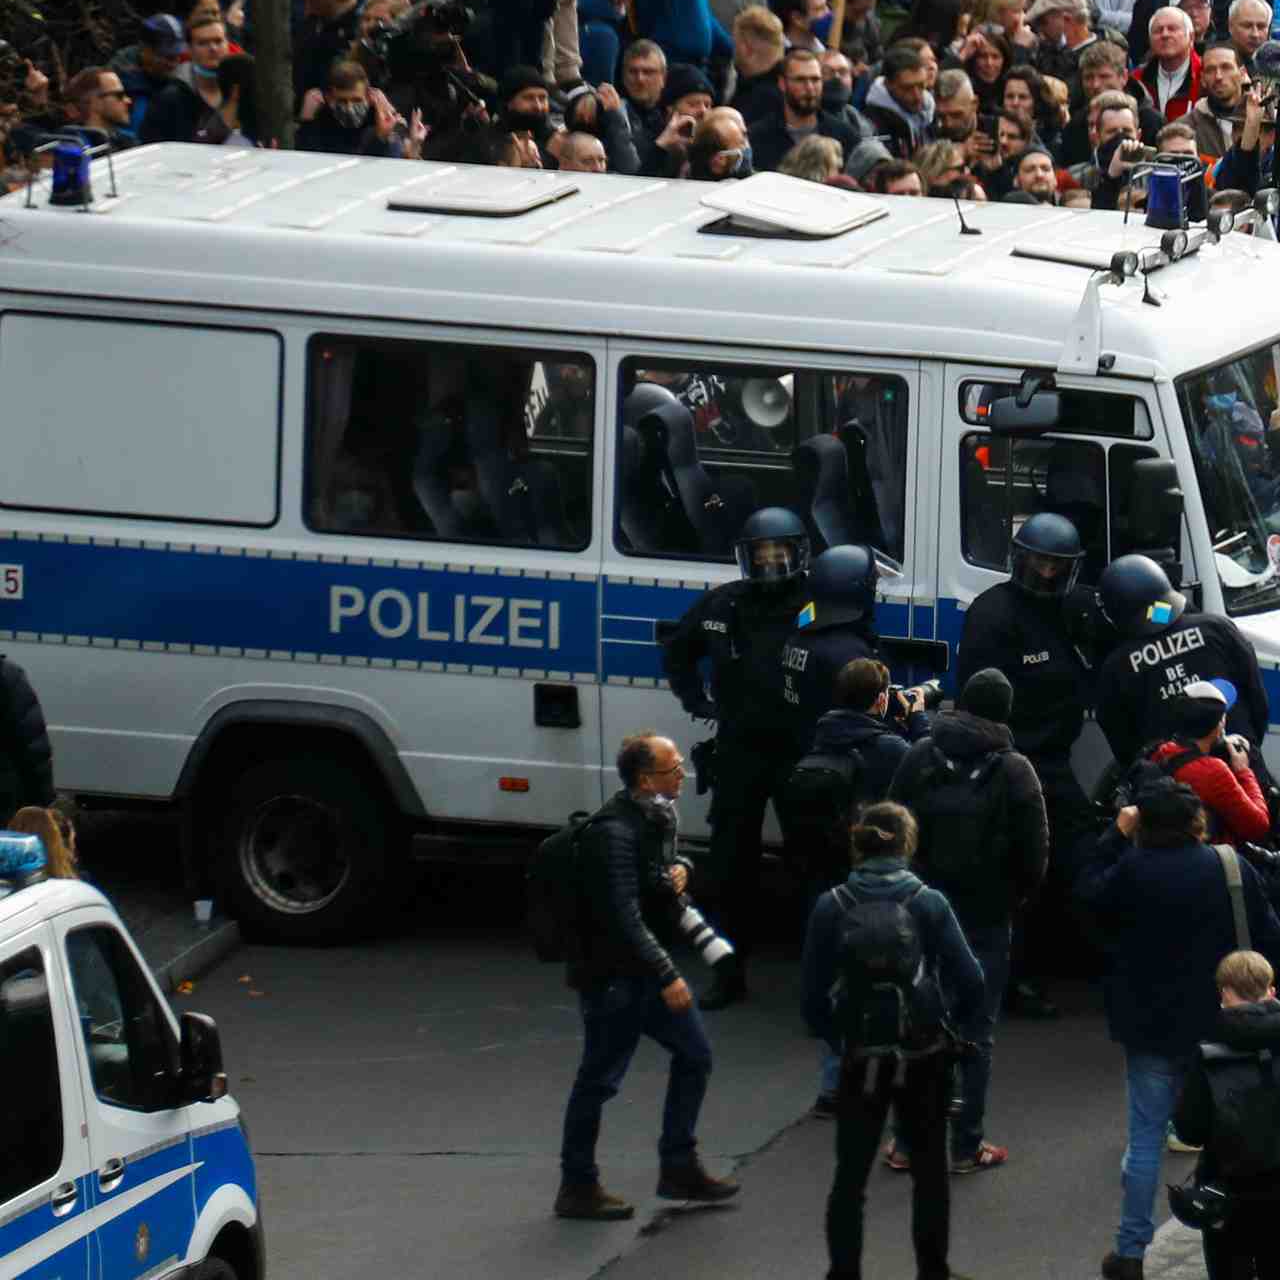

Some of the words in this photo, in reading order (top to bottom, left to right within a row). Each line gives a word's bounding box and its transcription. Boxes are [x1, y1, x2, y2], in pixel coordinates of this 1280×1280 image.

[328, 584, 561, 651] POLIZEI
[1129, 626, 1206, 673] POLIZEI
[1165, 663, 1187, 682] BE
